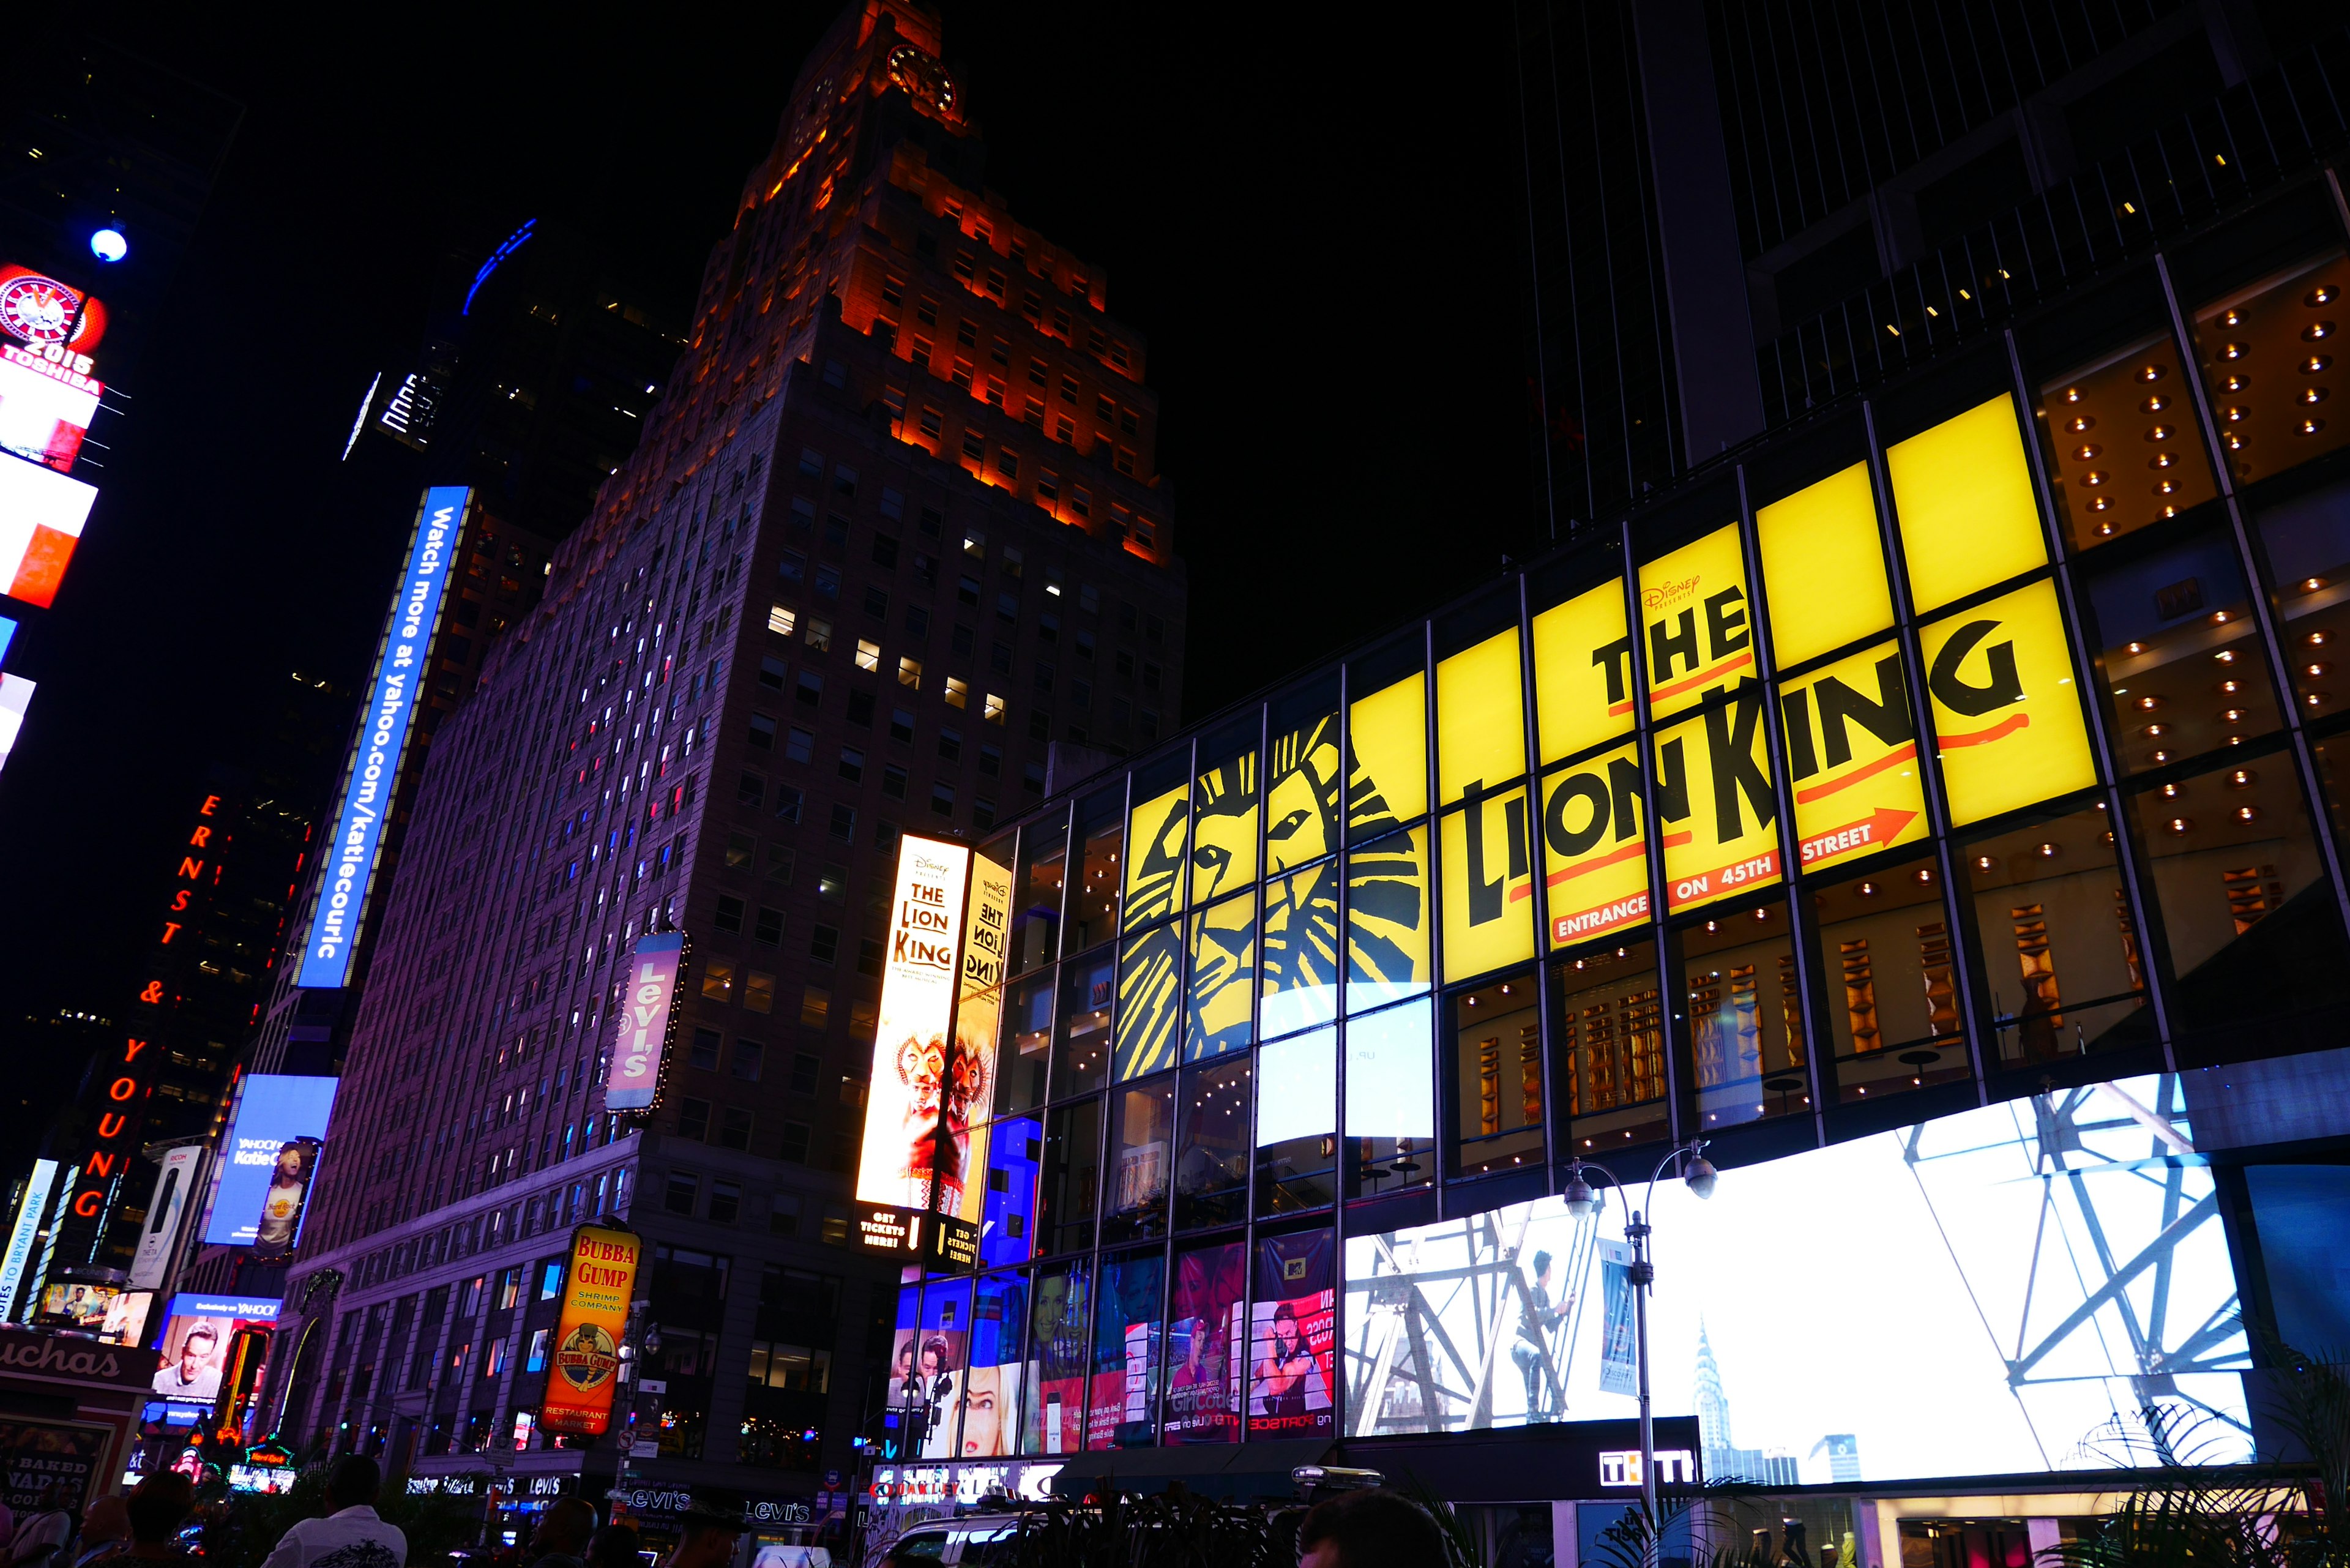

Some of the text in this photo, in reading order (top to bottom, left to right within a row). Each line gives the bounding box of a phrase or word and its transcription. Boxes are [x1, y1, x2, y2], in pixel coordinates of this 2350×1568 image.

[24, 337, 94, 375] 2015
[4, 343, 100, 395] TOSHIBA
[1641, 575, 1700, 608] Disney
[1655, 592, 1691, 611] PRESENTS
[1592, 584, 1750, 705] THE
[317, 506, 454, 960] Watch more at yahoo.com/katiecouric
[1463, 619, 2023, 927] LION KING
[912, 854, 949, 876] Disney
[1558, 824, 1871, 938] ENTRANCE ON 45TH STREET
[911, 883, 943, 903] THE
[901, 901, 948, 930] LION
[893, 930, 950, 965] KING
[75, 794, 220, 1217] ERNST & YOUNG
[239, 1138, 277, 1151] YAHOO!
[170, 1154, 187, 1162] RICOH
[234, 1150, 270, 1165] Katie
[873, 1212, 896, 1223] GET
[6, 1267, 18, 1283] TO
[12, 1222, 33, 1264] BRYANT
[26, 1192, 43, 1219] PARK
[860, 1221, 905, 1236] TICKETS
[577, 1234, 635, 1265] BUBBA
[865, 1234, 898, 1248] HERE!
[577, 1261, 629, 1288] GUMP
[570, 1299, 624, 1313] COMPANY
[578, 1291, 621, 1302] SHRIMP
[238, 1303, 277, 1315] YAHOO!
[558, 1353, 616, 1370] BUBBA GUMP
[546, 1406, 608, 1420] RESTAURANT
[554, 1418, 596, 1430] MARKET
[18, 1457, 88, 1474] BAKED
[897, 1482, 960, 1496] OAKLEY
